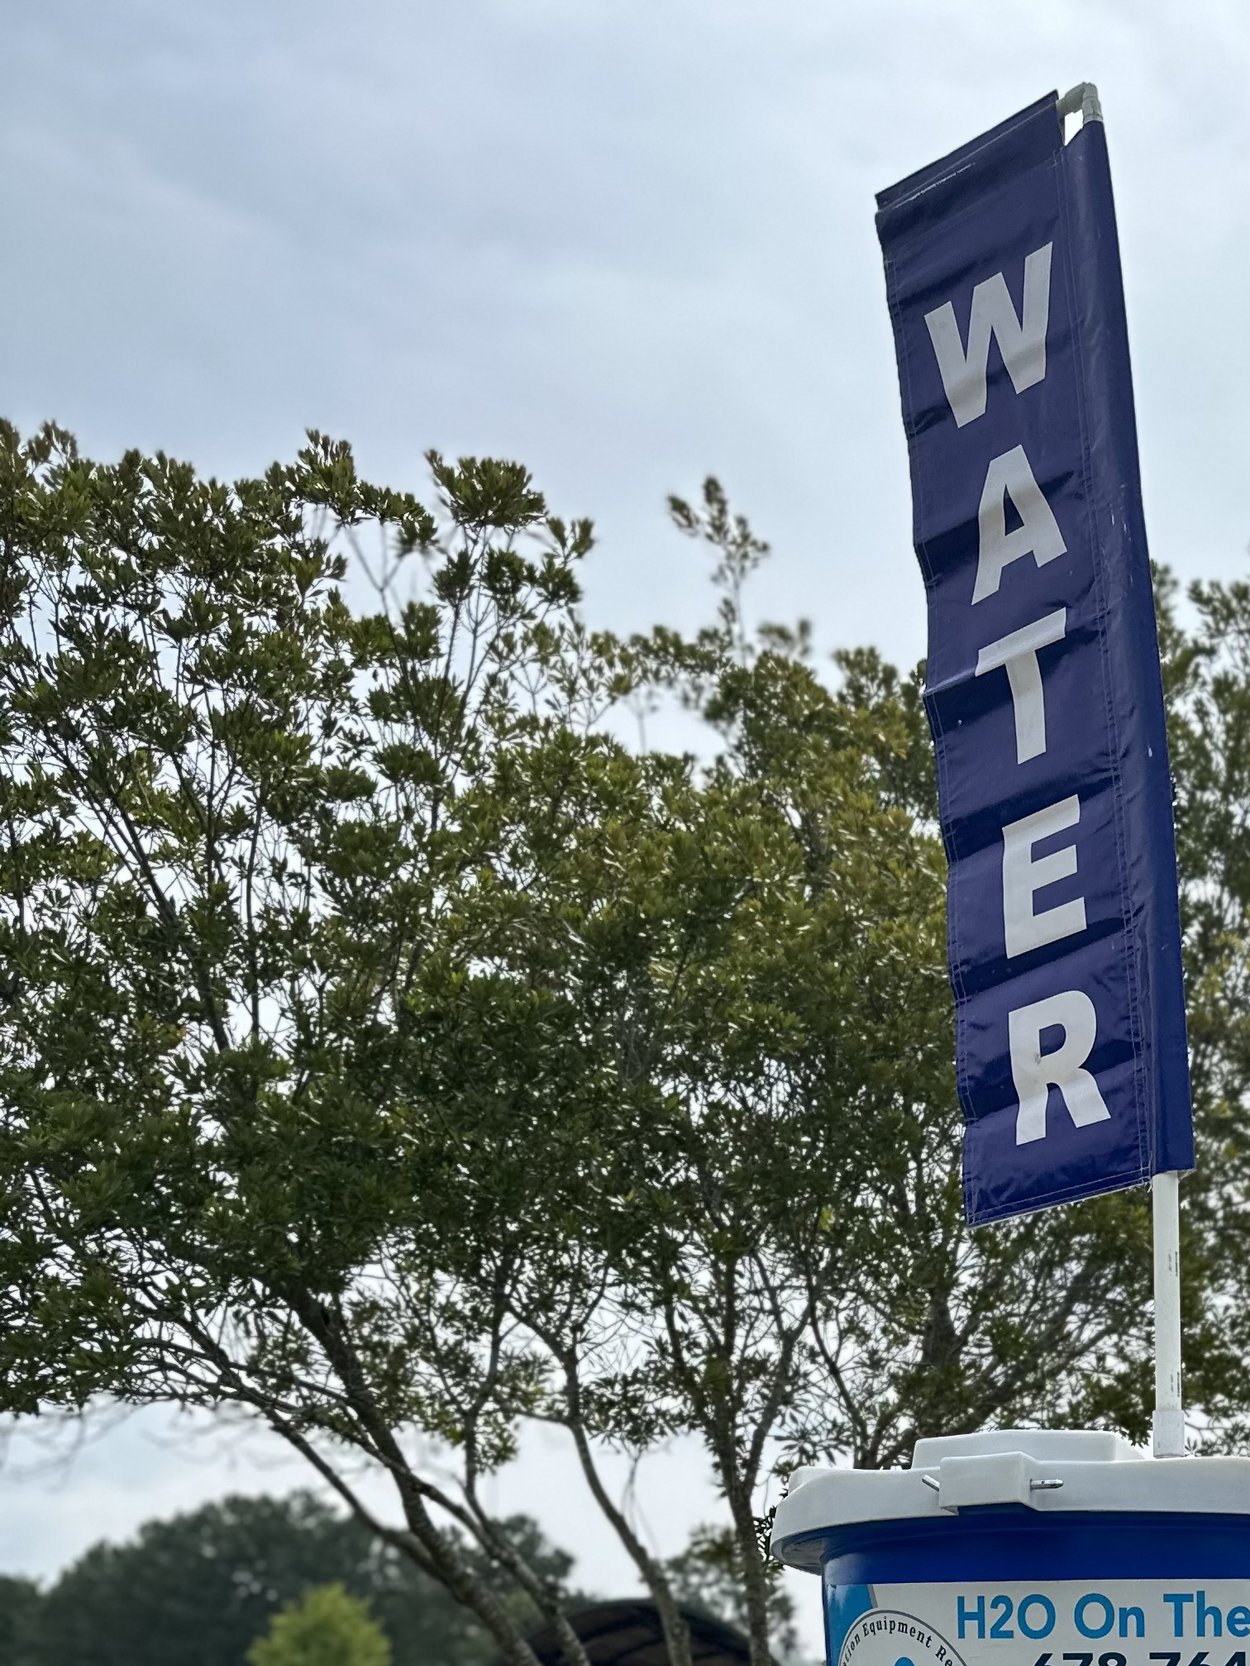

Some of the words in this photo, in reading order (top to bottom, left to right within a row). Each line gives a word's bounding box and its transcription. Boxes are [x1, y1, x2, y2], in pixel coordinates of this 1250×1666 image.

[923, 240, 1112, 1147] WATER
[862, 1615, 932, 1648] Equipment
[1074, 1593, 1145, 1639] On
